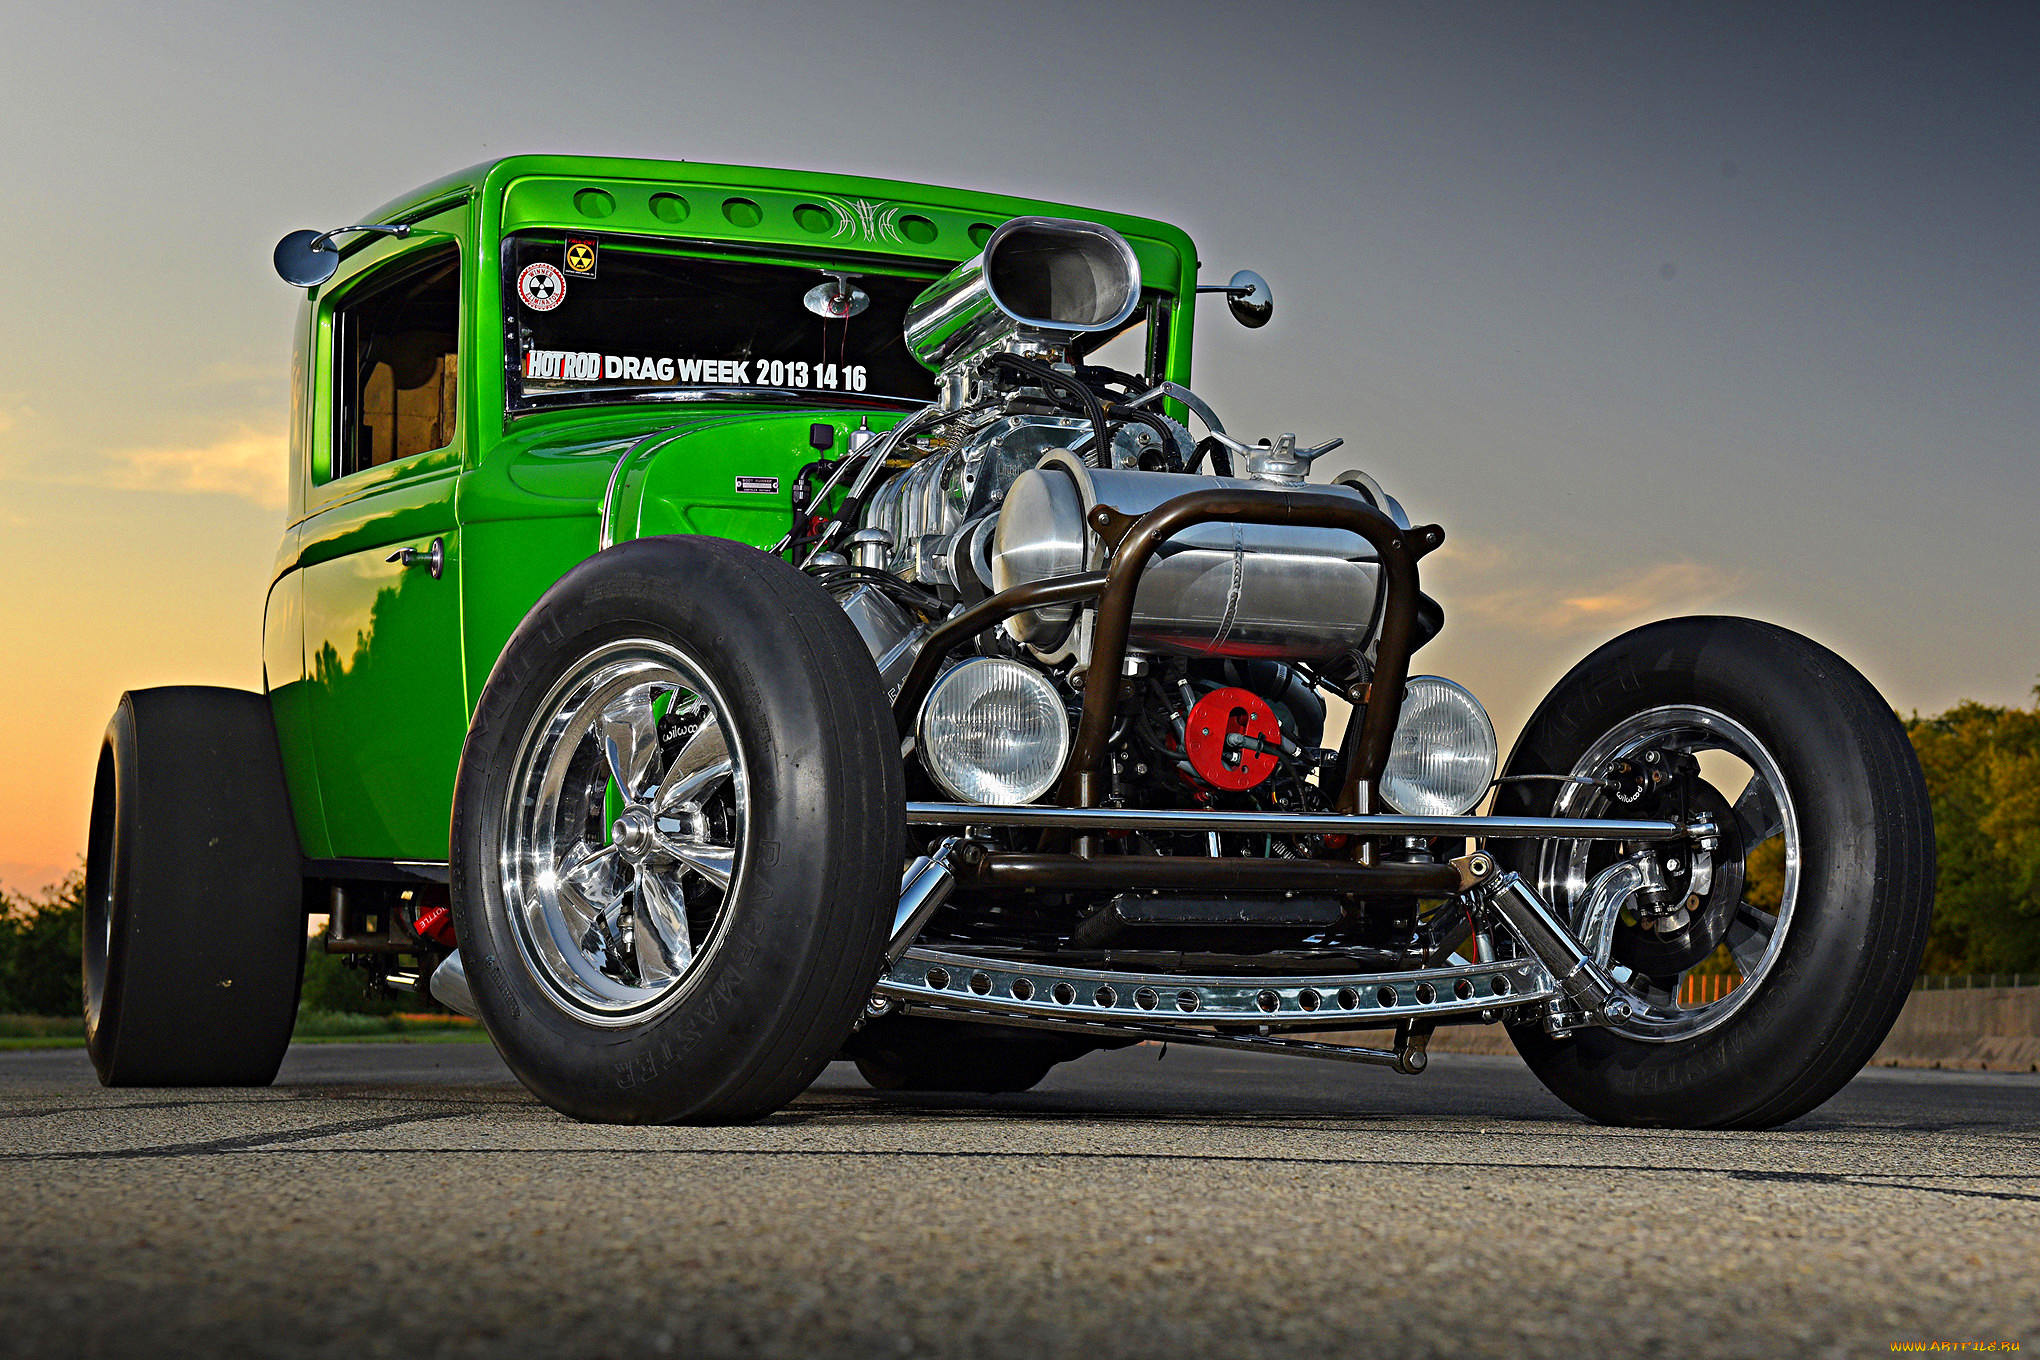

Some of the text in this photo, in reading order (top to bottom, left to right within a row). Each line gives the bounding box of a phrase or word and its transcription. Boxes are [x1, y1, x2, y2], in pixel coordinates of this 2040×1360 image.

[529, 268, 554, 277] WINNER
[525, 292, 560, 305] ELIMINATOR
[527, 350, 867, 391] HOT ROD DRAG WEEK 2013 14 16
[662, 724, 698, 743] wilwoo
[1616, 785, 1643, 803] wilwood
